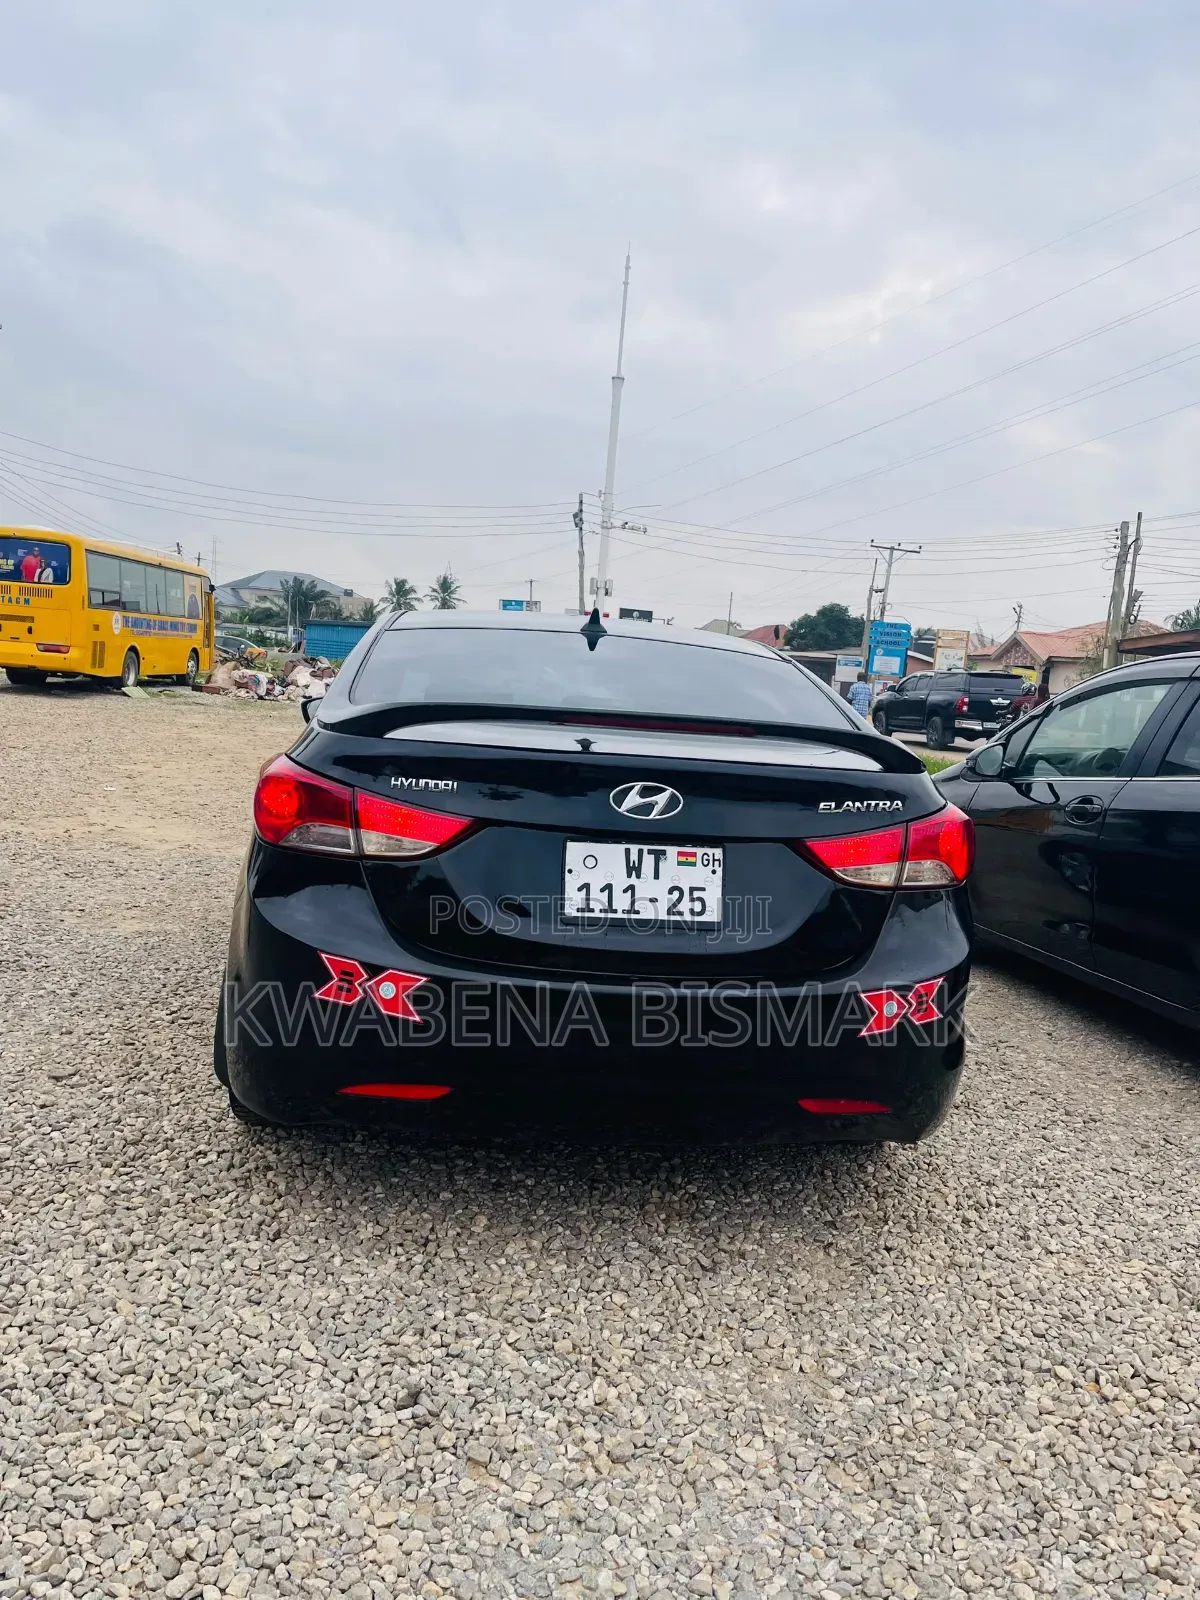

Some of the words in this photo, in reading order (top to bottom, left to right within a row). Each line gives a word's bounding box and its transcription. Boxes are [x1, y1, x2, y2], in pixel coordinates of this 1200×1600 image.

[390, 776, 458, 793] HYUNDAI
[817, 800, 904, 813] ELANTRA
[624, 847, 667, 880] WT
[701, 852, 722, 868] GH
